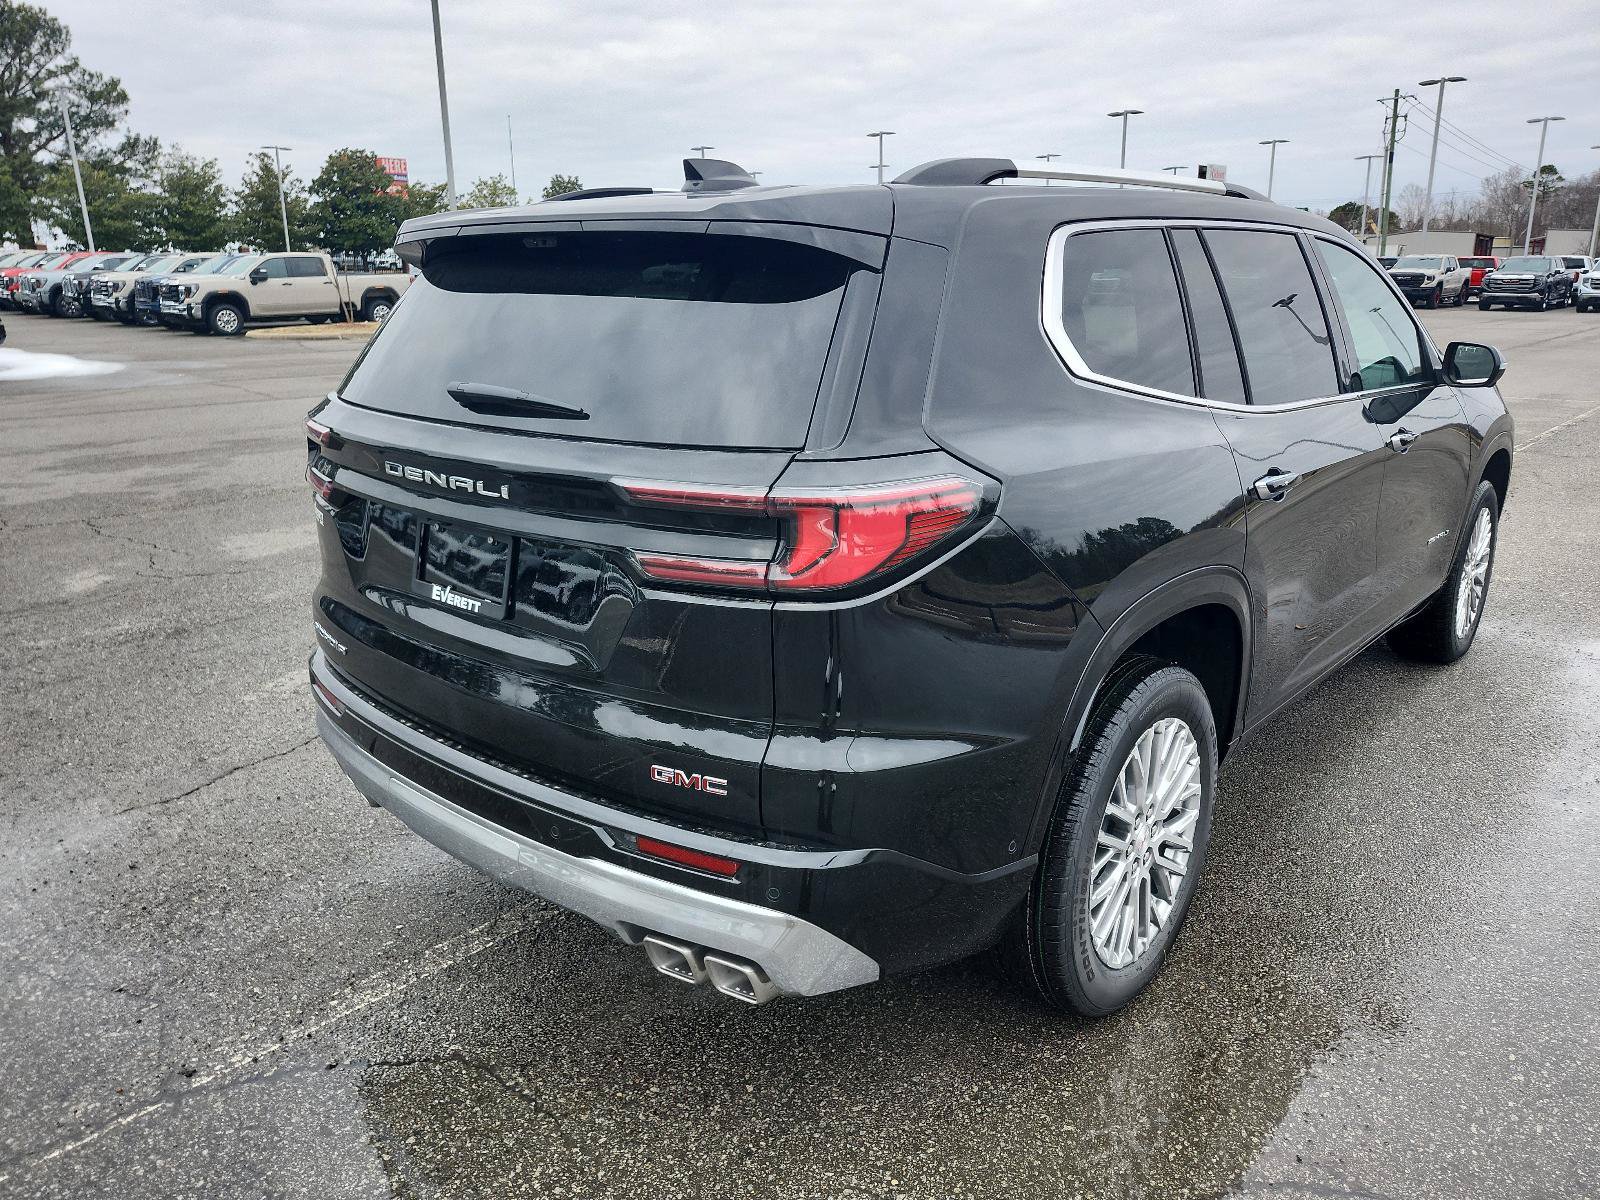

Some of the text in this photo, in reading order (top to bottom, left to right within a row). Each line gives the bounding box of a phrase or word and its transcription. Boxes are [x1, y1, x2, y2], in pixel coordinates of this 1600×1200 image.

[384, 460, 510, 500] DENALI
[431, 583, 482, 613] EVERETT
[650, 764, 728, 796] GMC
